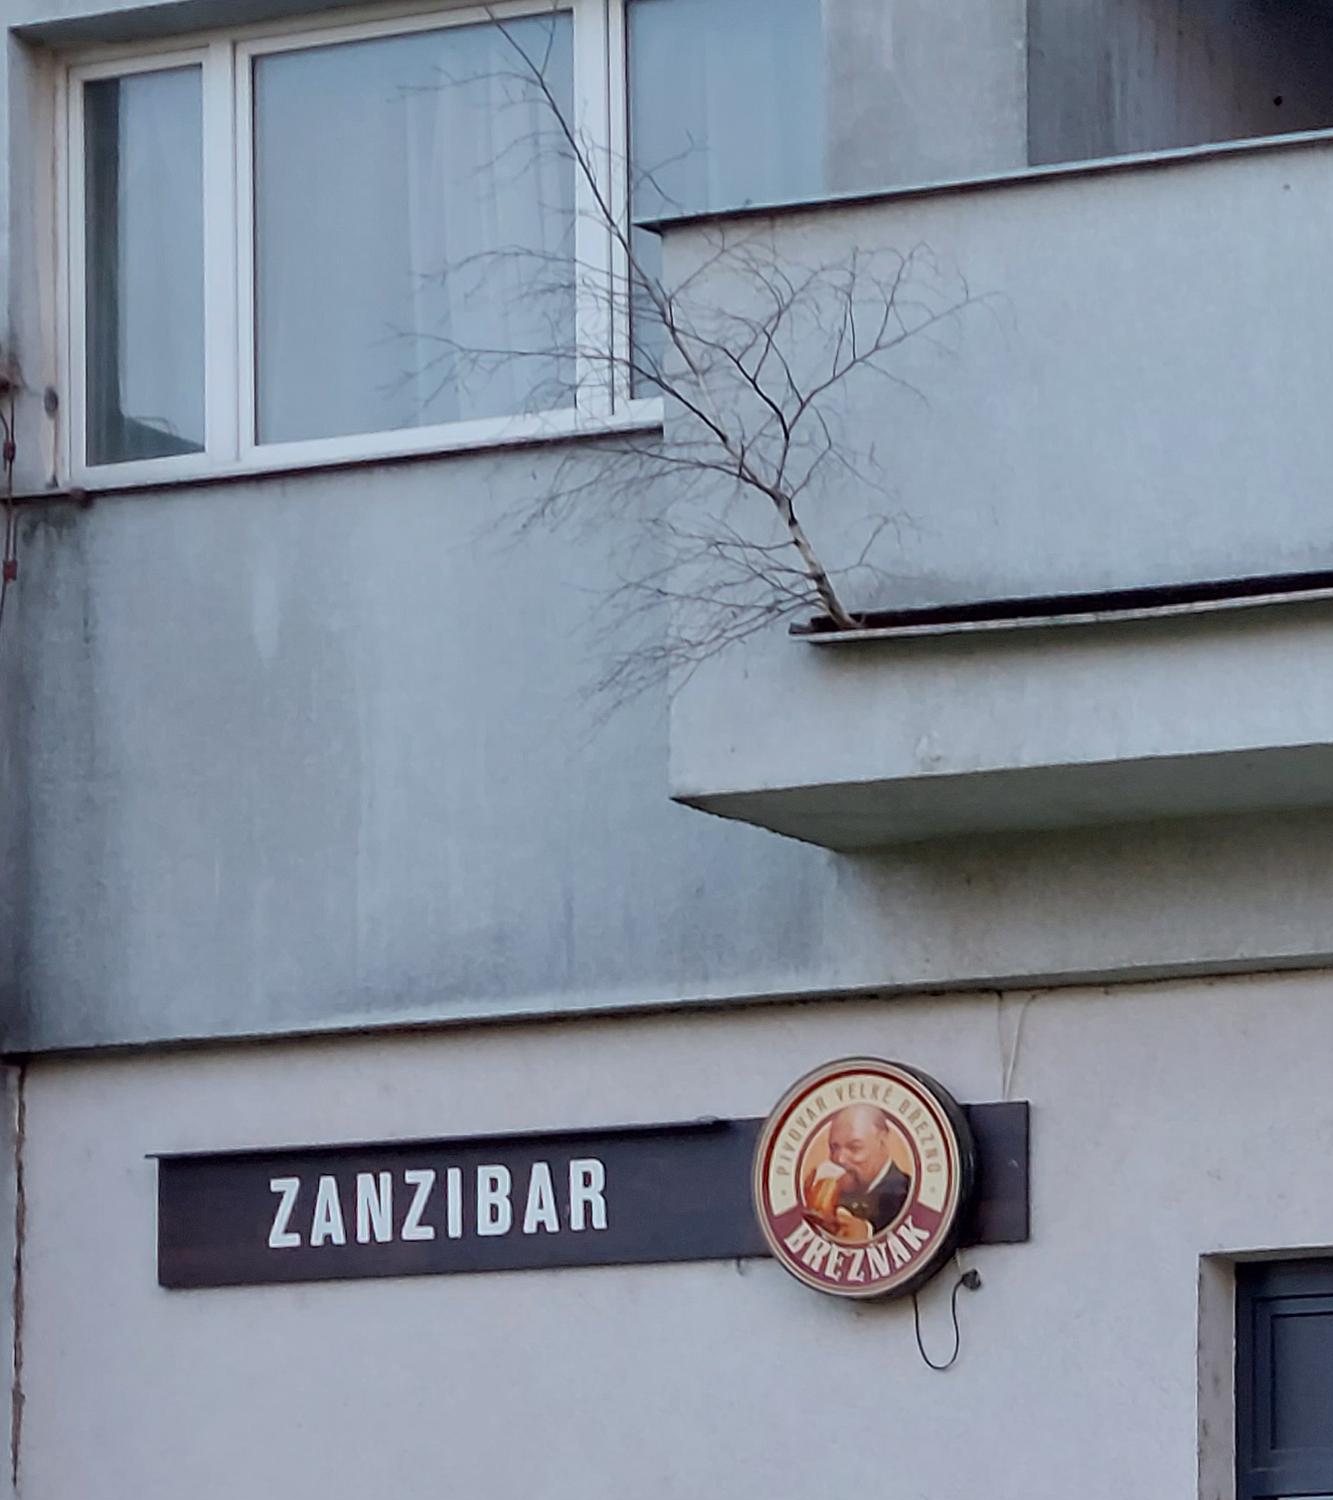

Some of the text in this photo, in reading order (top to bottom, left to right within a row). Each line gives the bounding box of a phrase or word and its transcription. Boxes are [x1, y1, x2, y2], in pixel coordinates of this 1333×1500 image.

[776, 1096, 828, 1177] PIVOVAR
[834, 1080, 894, 1101] VELKÉ
[268, 1157, 608, 1249] ZANZIBAR
